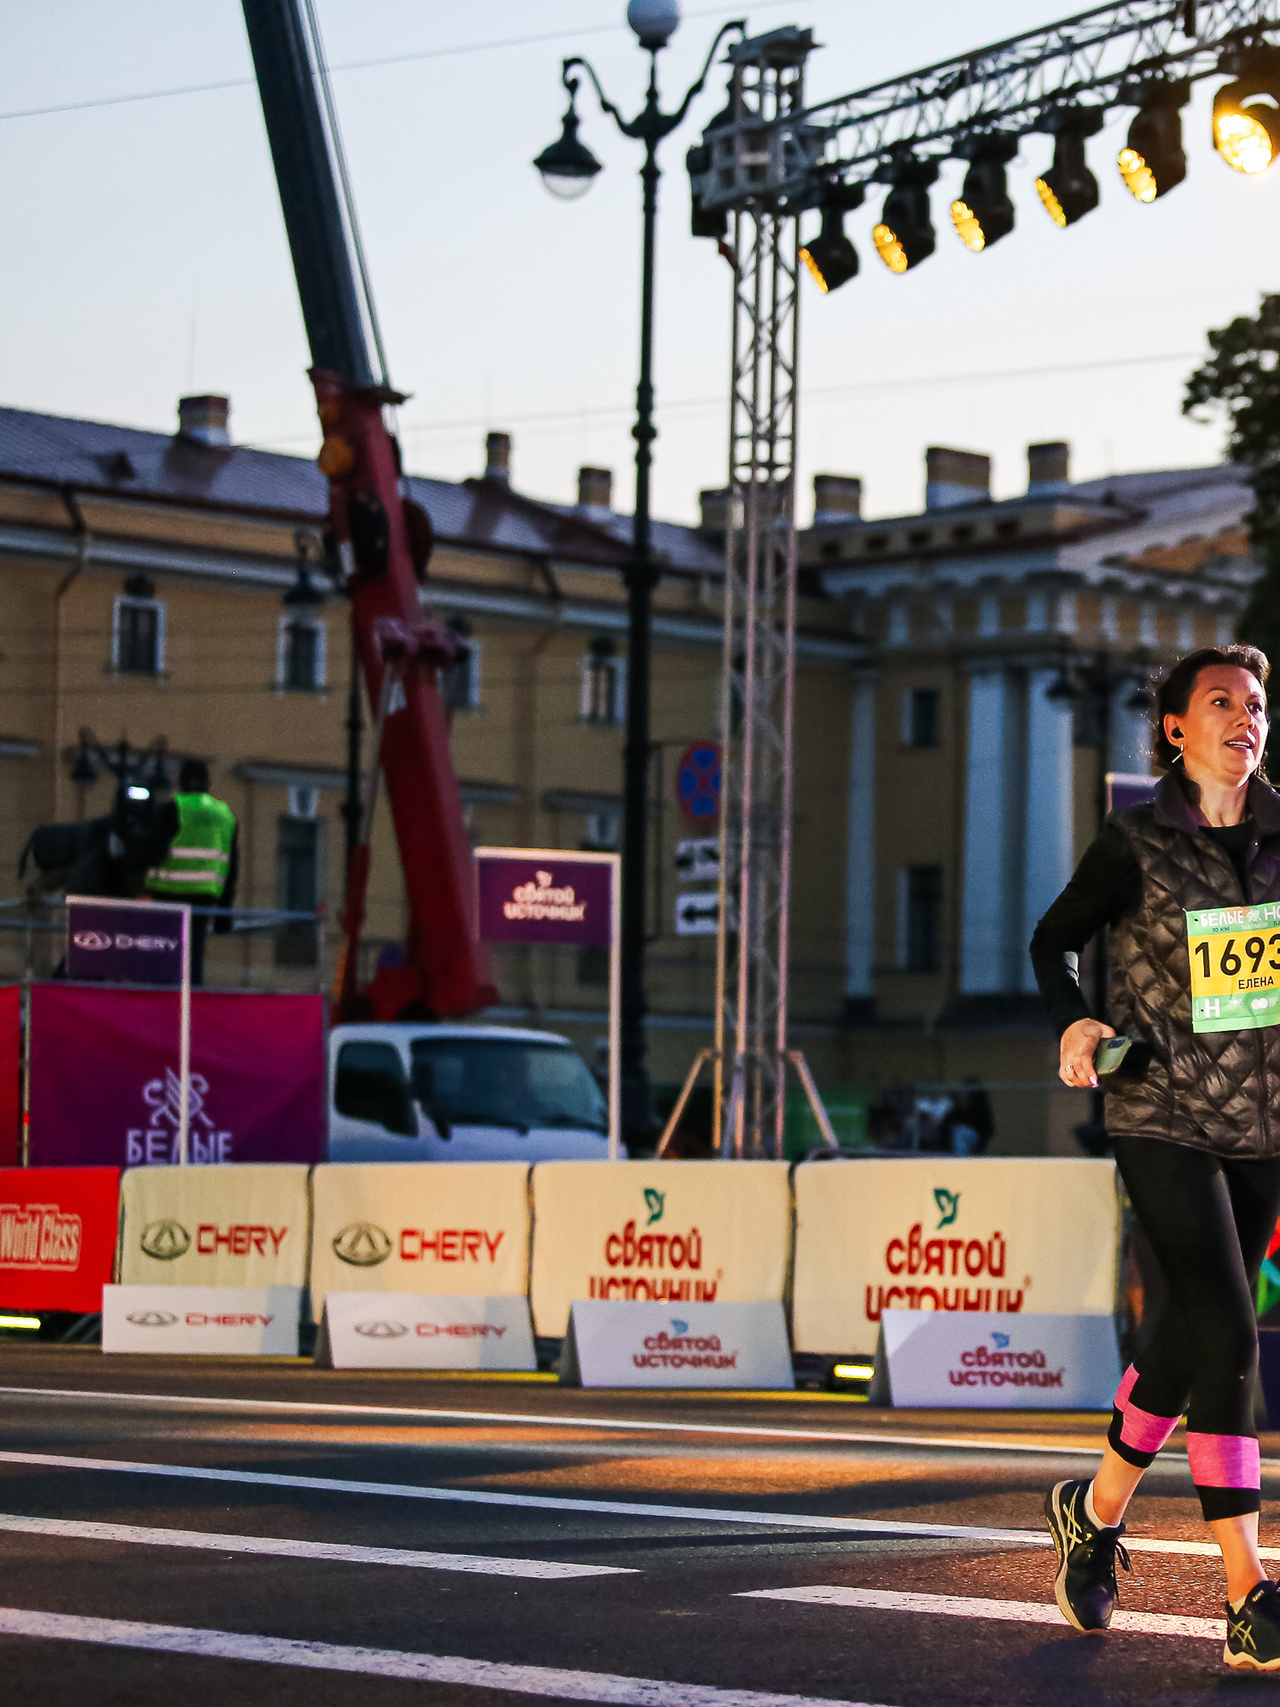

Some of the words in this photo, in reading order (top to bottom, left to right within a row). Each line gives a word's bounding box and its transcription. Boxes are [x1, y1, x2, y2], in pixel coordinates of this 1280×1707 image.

[1200, 910, 1244, 927] БЕЛЫЕ
[114, 933, 179, 950] CHERY
[1238, 976, 1274, 990] ЕЛЕНА
[0, 1214, 40, 1261] World
[40, 1214, 79, 1262] Class
[197, 1223, 288, 1257] CHERY
[400, 1228, 506, 1263] CHERY
[185, 1312, 275, 1327] CHERY
[415, 1323, 507, 1337] CHERY
